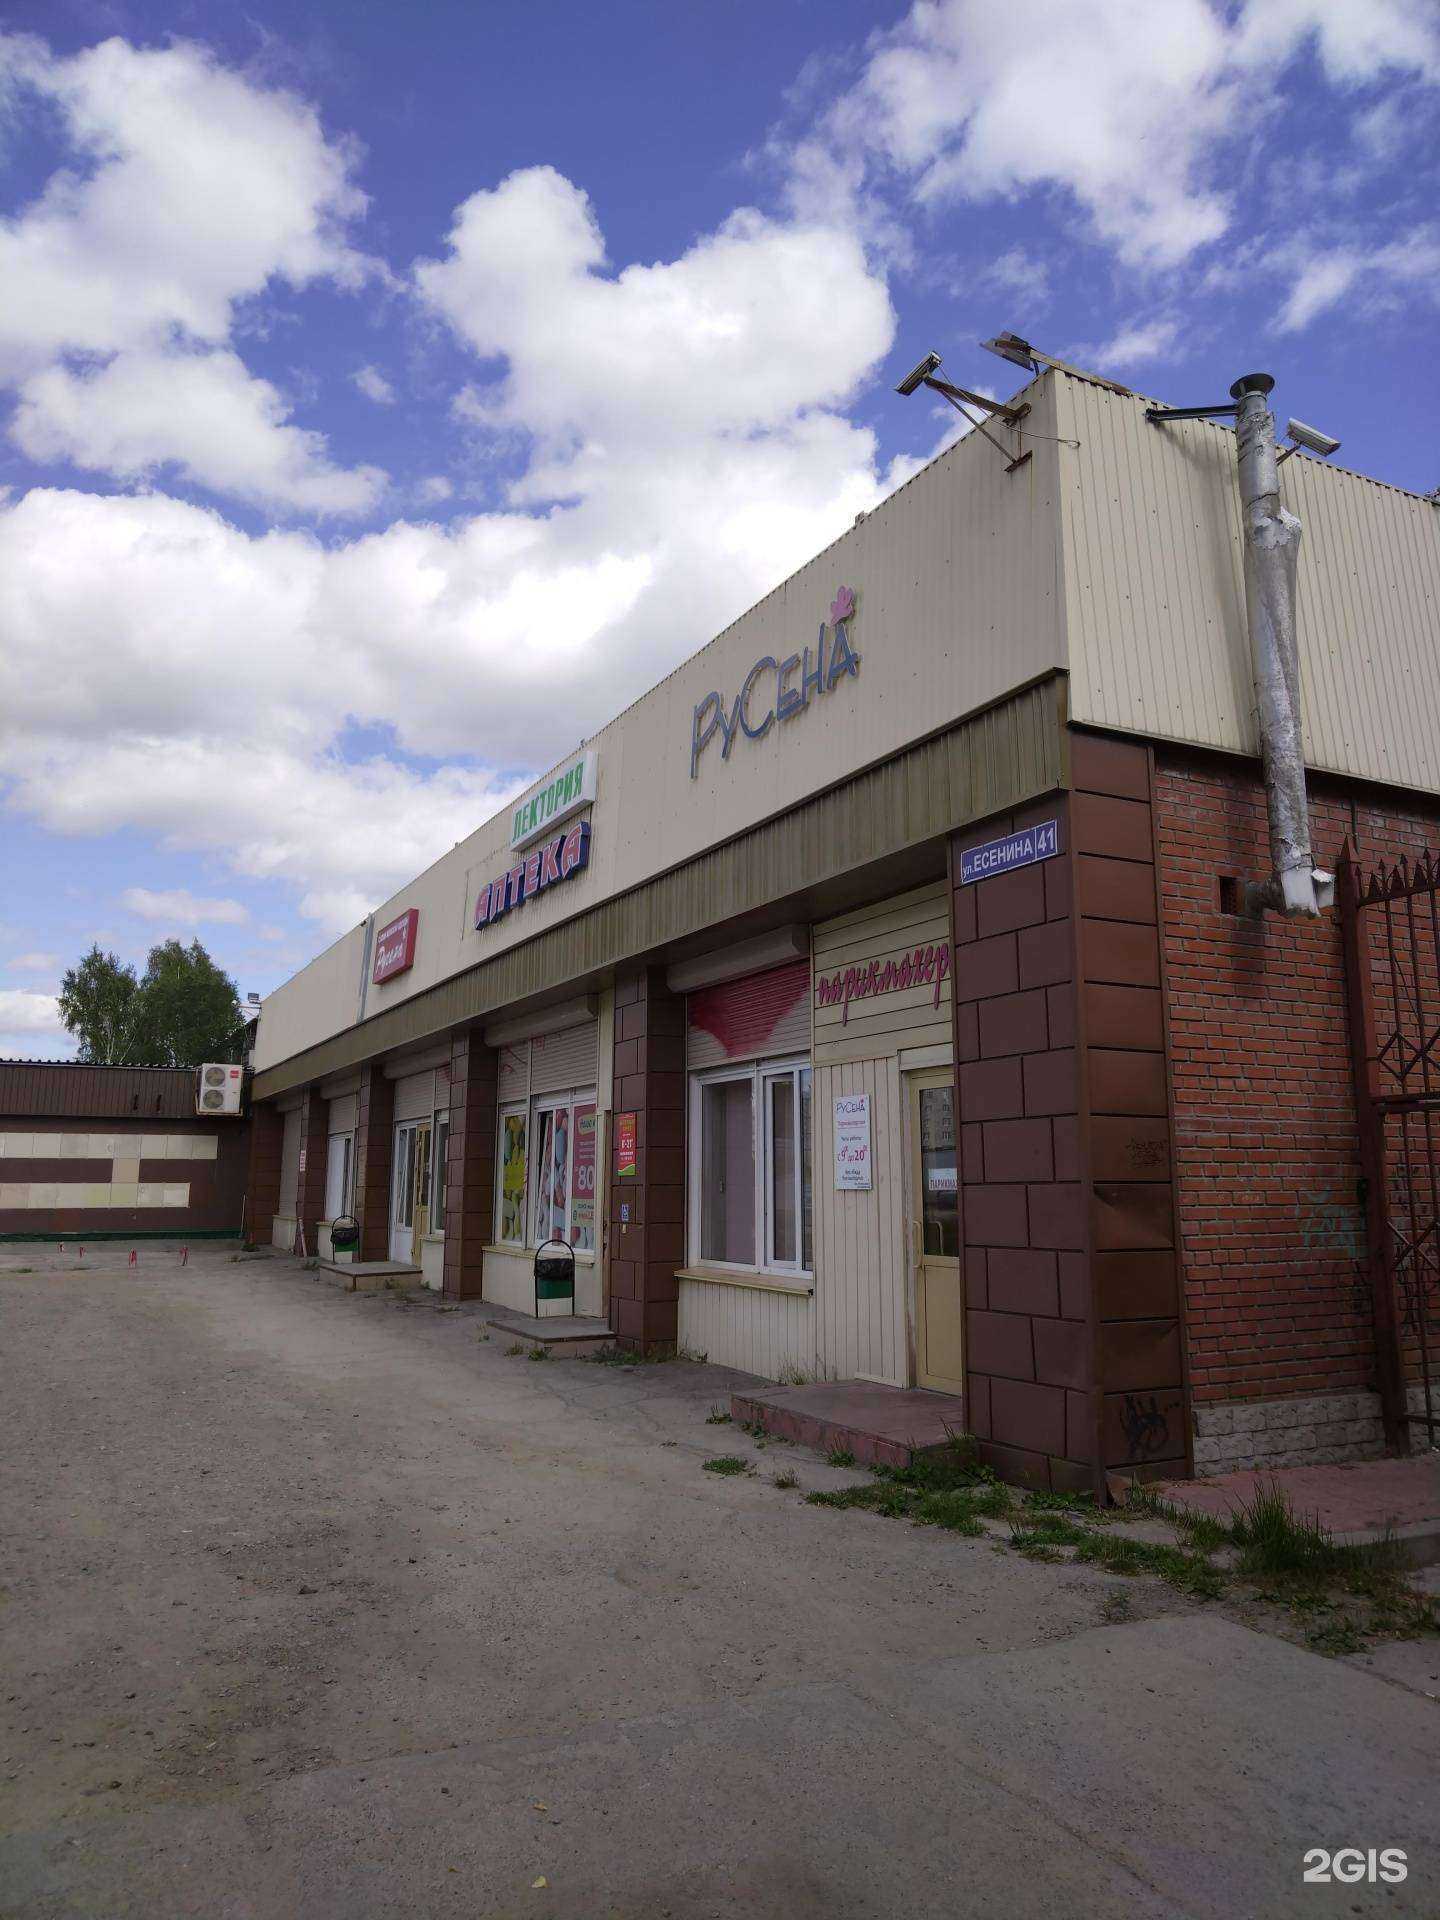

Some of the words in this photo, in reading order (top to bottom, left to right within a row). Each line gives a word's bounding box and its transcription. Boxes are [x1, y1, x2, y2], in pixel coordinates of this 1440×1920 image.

[475, 822, 591, 930] АПТЕКА
[973, 838, 1033, 872] ЕСЕНИНА
[1037, 827, 1055, 852] 41
